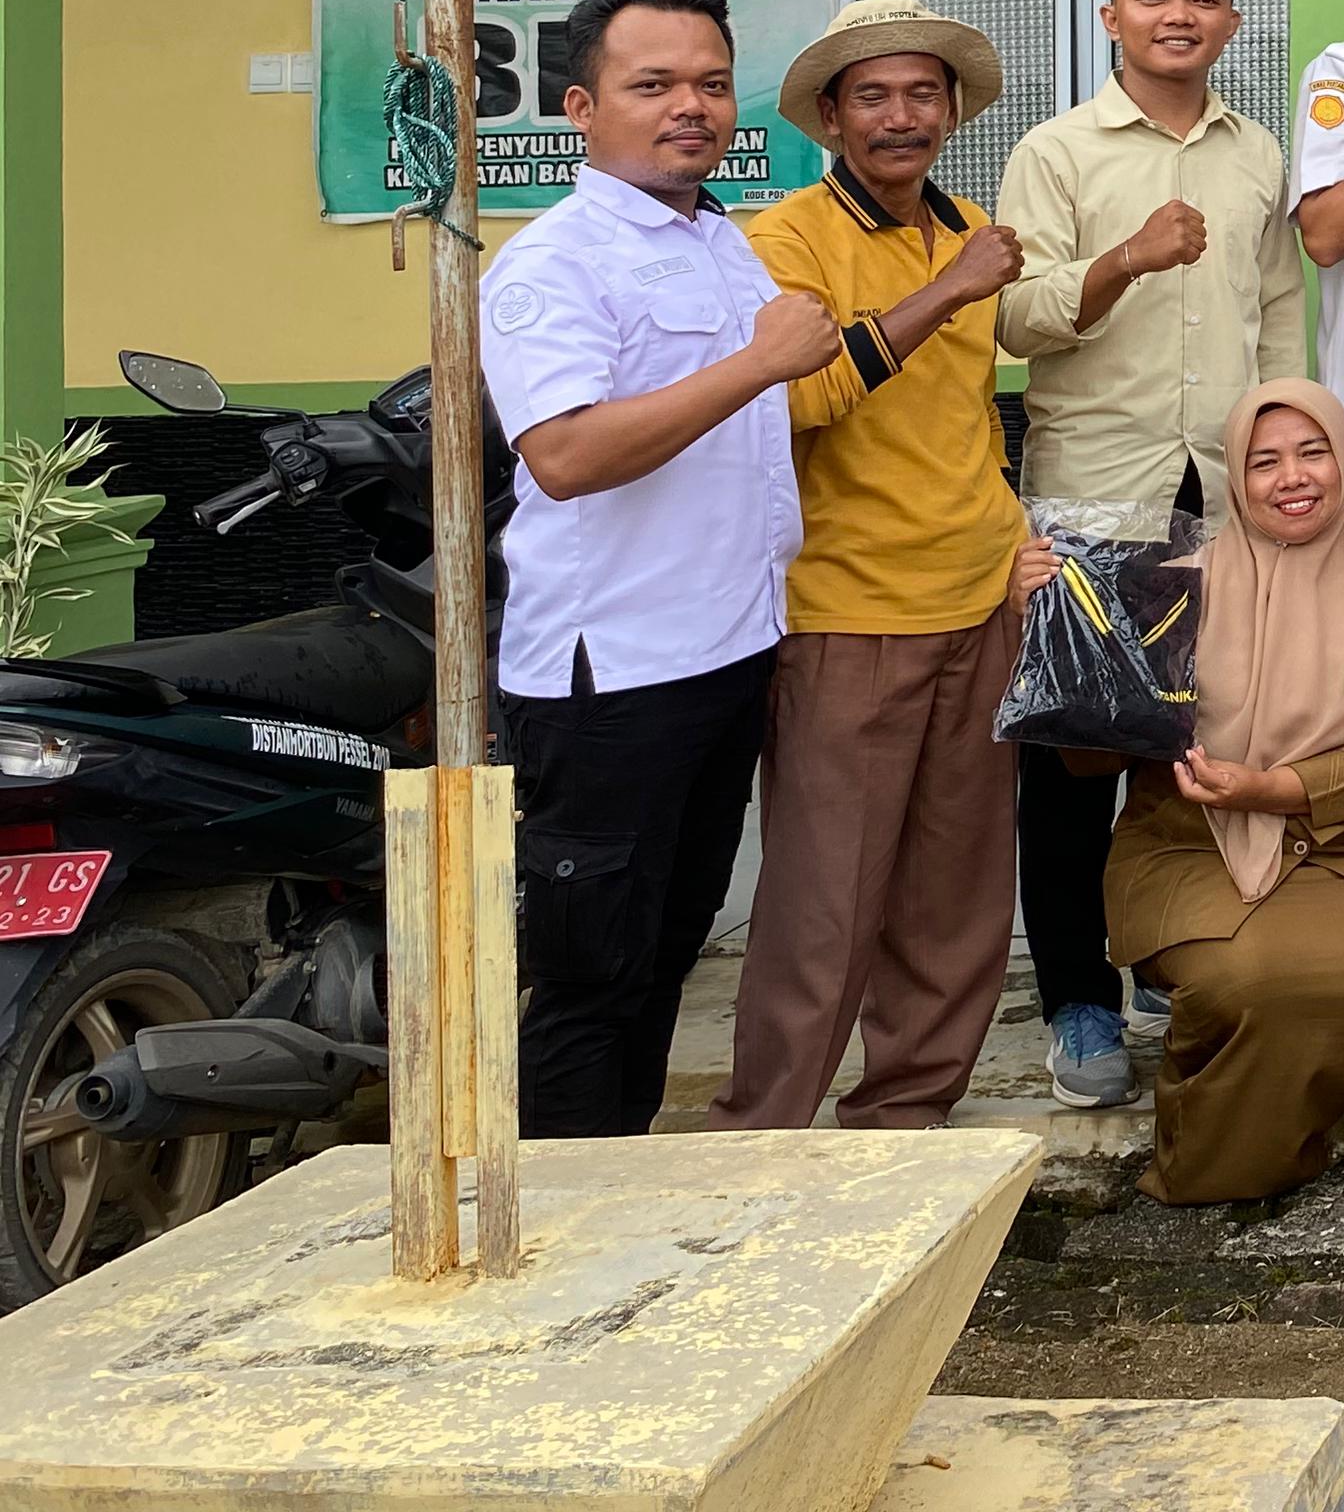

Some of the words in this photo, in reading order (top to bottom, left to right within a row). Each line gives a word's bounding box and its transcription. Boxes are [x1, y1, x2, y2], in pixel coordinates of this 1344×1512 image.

[476, 133, 588, 157] PENYULUH
[538, 162, 580, 184] BAS
[744, 190, 766, 200] KODE
[768, 190, 785, 200] POS
[338, 737, 372, 770] PESSEL
[335, 796, 376, 822] YAMAHA
[48, 860, 96, 893] GS
